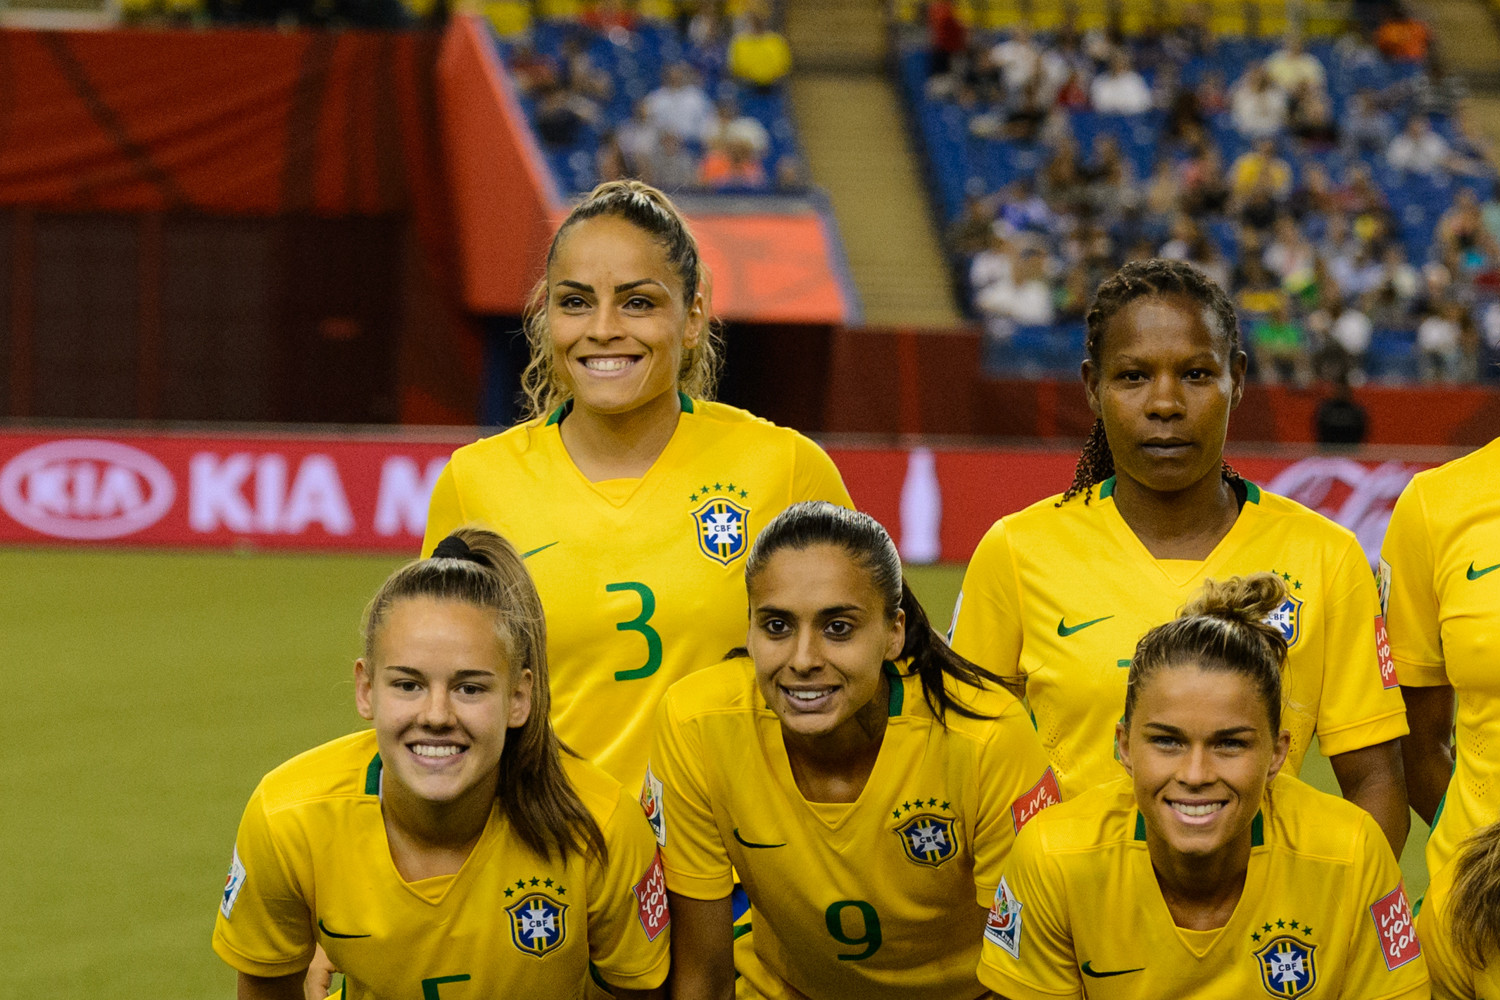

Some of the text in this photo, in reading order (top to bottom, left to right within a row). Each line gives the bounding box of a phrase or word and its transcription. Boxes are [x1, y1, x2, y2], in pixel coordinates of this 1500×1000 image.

[27, 463, 143, 516] KIA
[188, 453, 356, 535] KIA
[605, 582, 663, 682] 3
[1020, 786, 1047, 822] LIVE
[919, 835, 938, 844] CBF
[529, 920, 548, 928] CBF
[824, 899, 883, 961] 9
[1278, 963, 1297, 971] CBF
